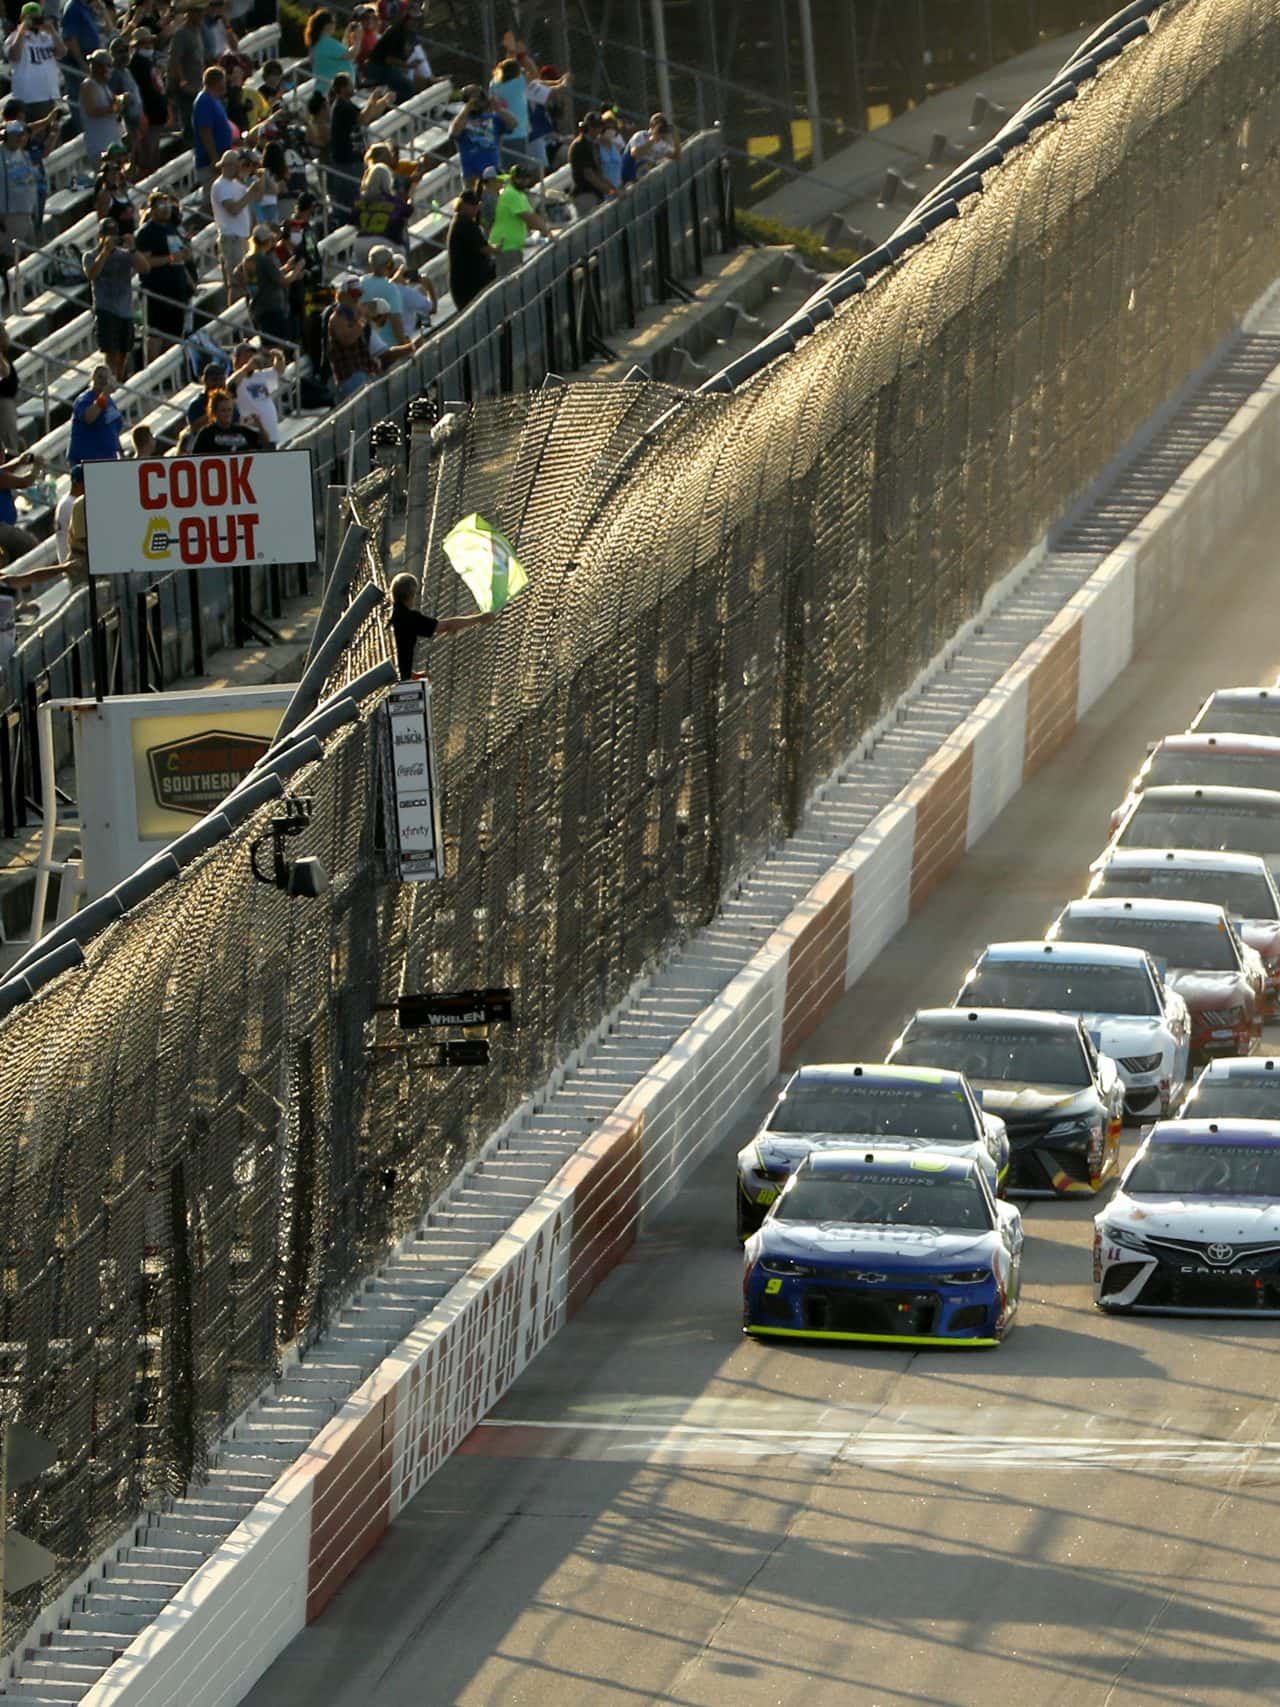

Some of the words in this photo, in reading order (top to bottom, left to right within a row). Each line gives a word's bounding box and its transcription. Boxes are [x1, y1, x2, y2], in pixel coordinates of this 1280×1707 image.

[138, 456, 257, 510] COOK
[178, 513, 259, 565] OUT
[163, 771, 241, 793] SOUTHERN
[401, 824, 430, 840] xfinity
[427, 1010, 486, 1025] WHELEN
[1180, 1265, 1261, 1276] CAMRY
[765, 1278, 783, 1295] 9
